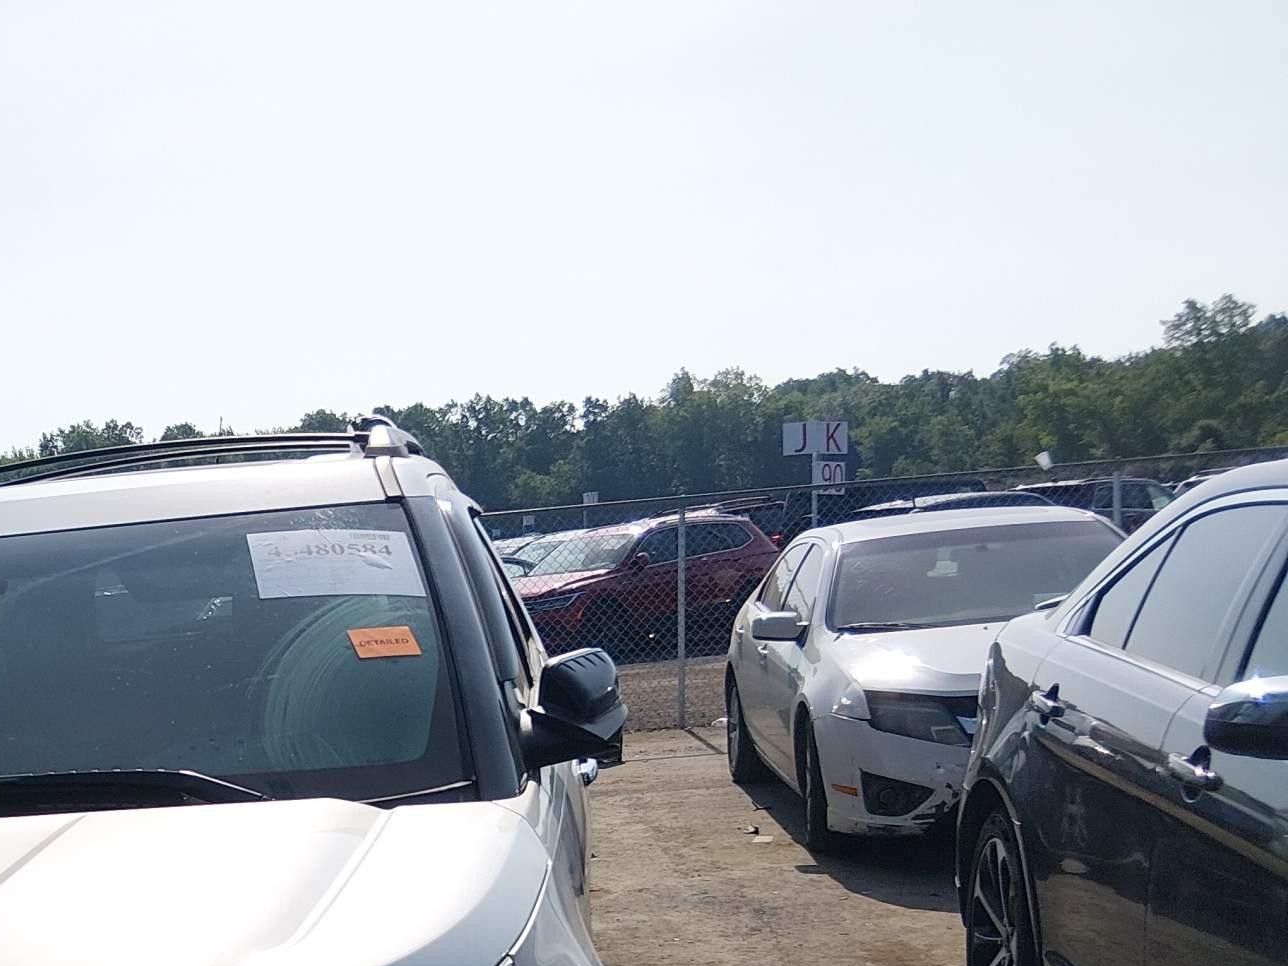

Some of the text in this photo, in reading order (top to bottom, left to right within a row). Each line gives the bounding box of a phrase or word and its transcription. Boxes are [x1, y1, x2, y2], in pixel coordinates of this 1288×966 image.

[794, 423, 841, 453] J K
[821, 463, 844, 492] 90
[358, 638, 410, 647] DETAILED
